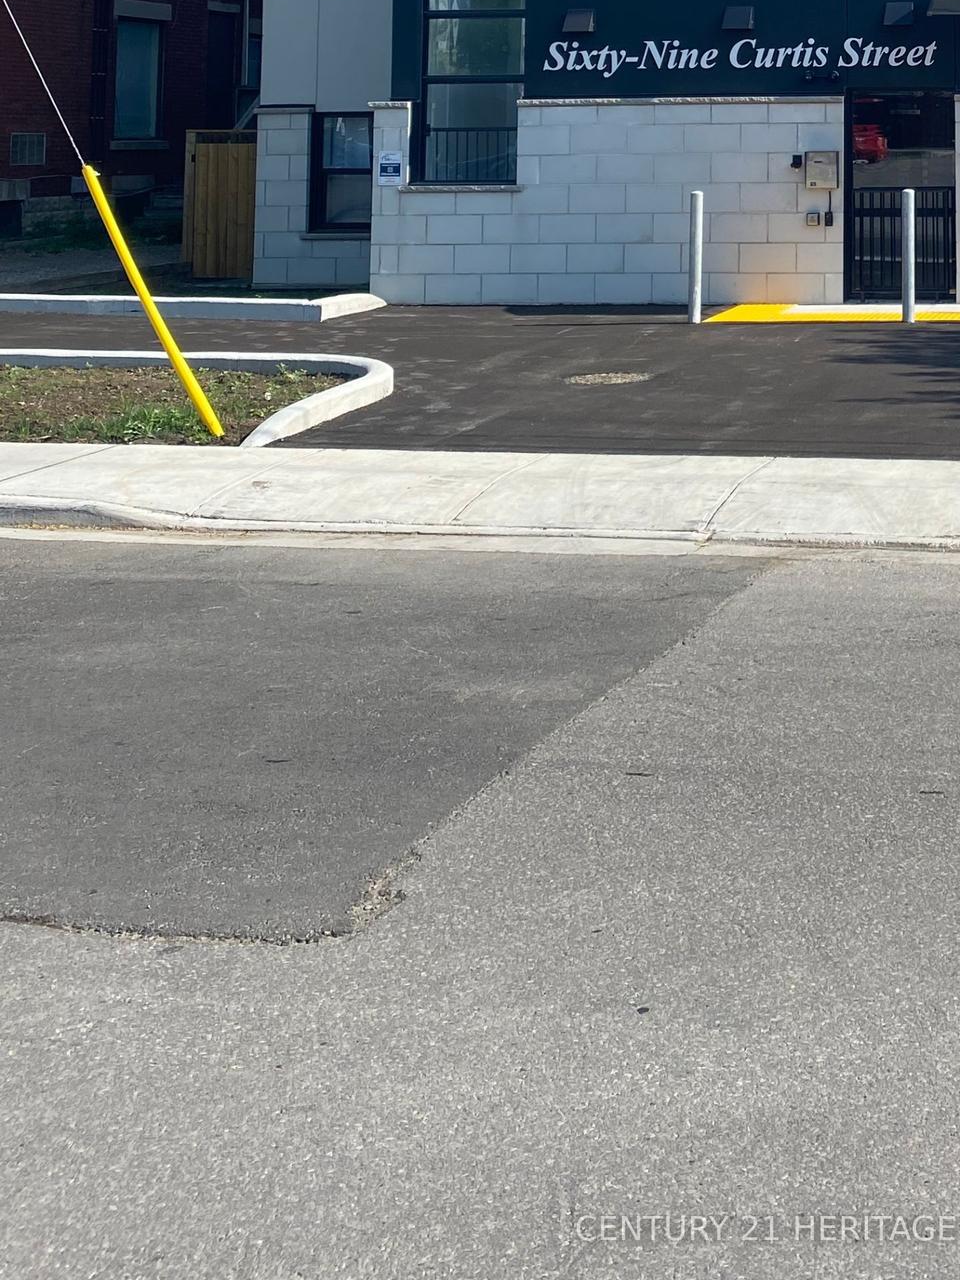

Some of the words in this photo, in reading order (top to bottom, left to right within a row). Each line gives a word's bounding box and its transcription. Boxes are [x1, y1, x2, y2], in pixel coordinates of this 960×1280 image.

[543, 40, 718, 78] Sixty-Nine
[729, 38, 829, 69] Curtis
[837, 37, 937, 67] Street
